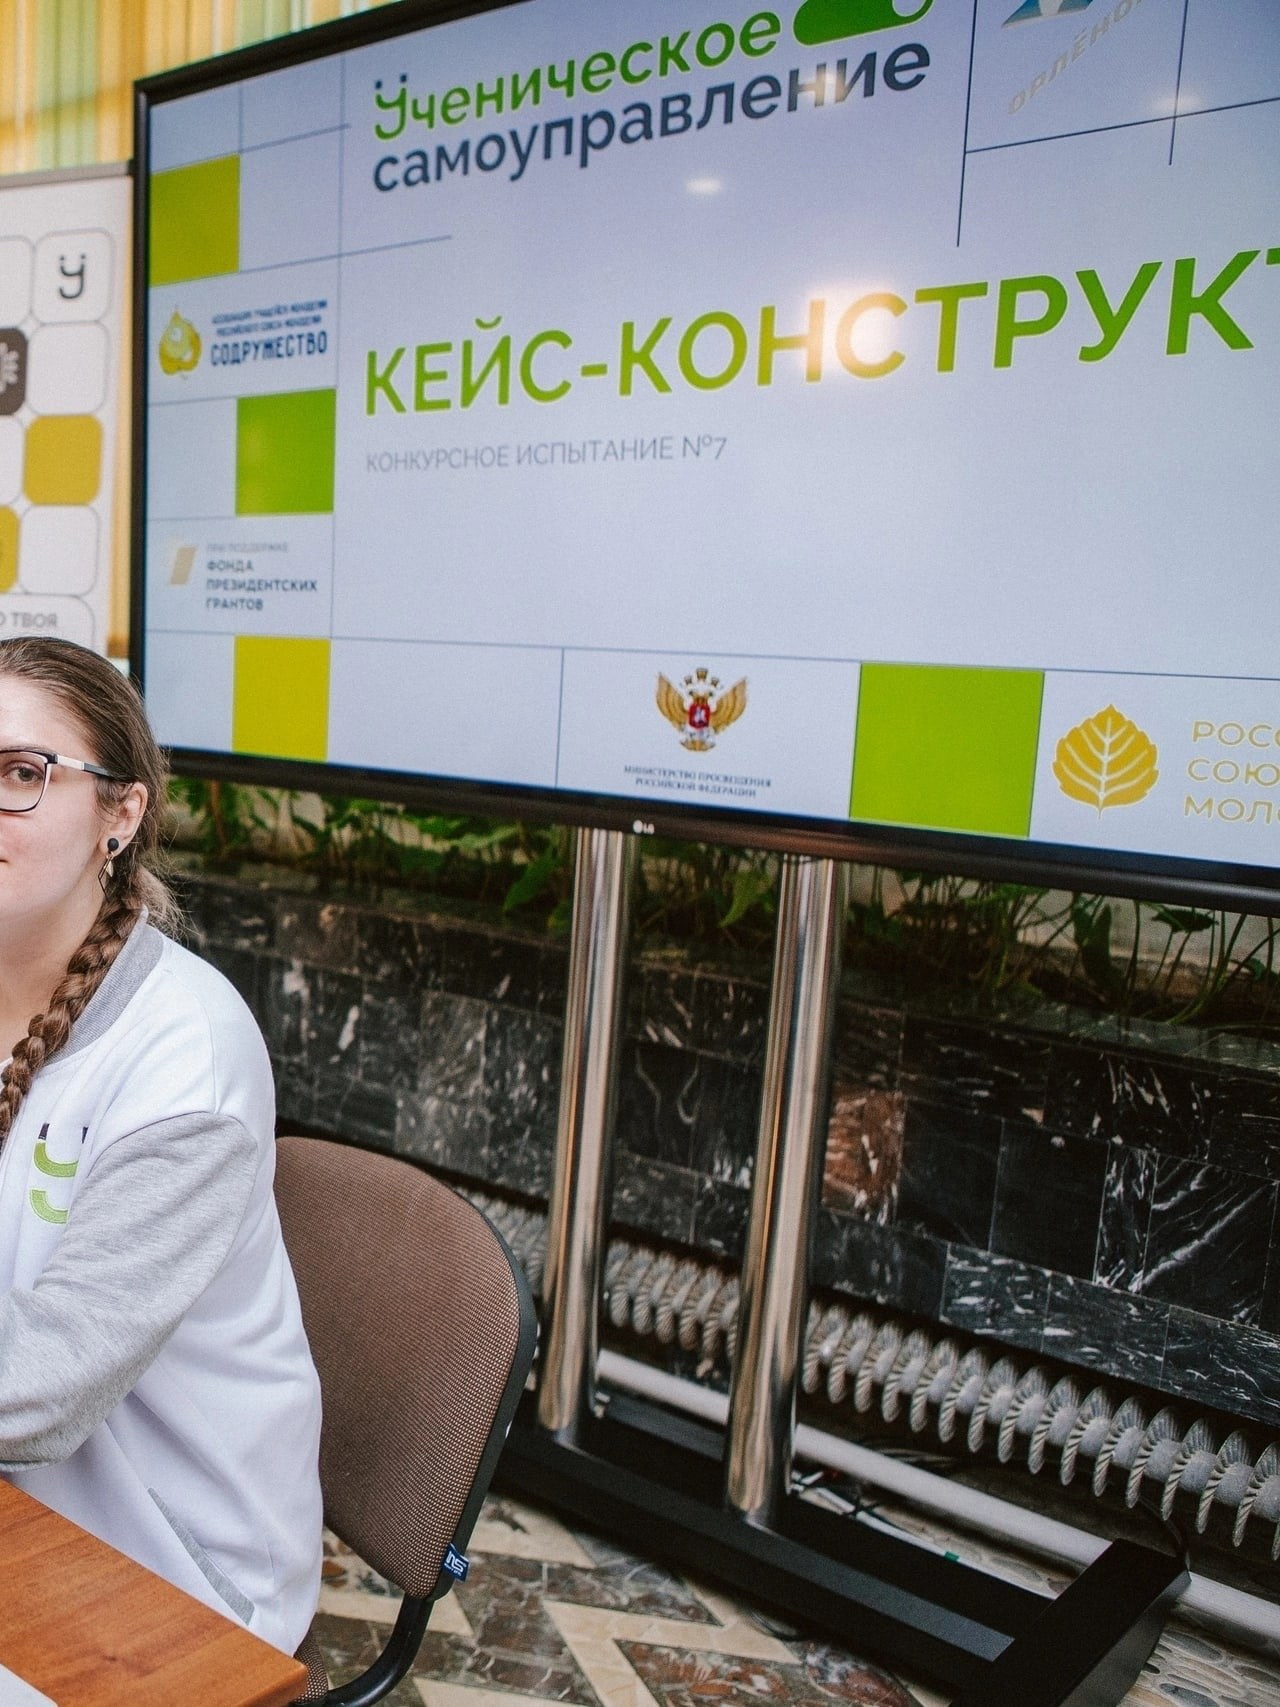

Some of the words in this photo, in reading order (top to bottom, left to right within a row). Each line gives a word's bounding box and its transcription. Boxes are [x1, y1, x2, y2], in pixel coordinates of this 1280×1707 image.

[1008, 0, 1143, 115] ОРЛЁНО
[373, 43, 930, 192] самоуправление
[210, 330, 328, 367] СОДРУЖЕСТВО
[366, 445, 509, 474] КОНКУРСНОЕ
[516, 436, 674, 465] ИСПЫТАНИЕ
[207, 559, 254, 573] ФОНДА
[206, 578, 318, 593] ПРЕЗИДЕНТСКИХ
[206, 597, 264, 611] ГРАНТОВ
[12, 612, 58, 628] ТВОЯ
[1191, 720, 1280, 748] РОС
[1184, 796, 1280, 824] МОЛ
